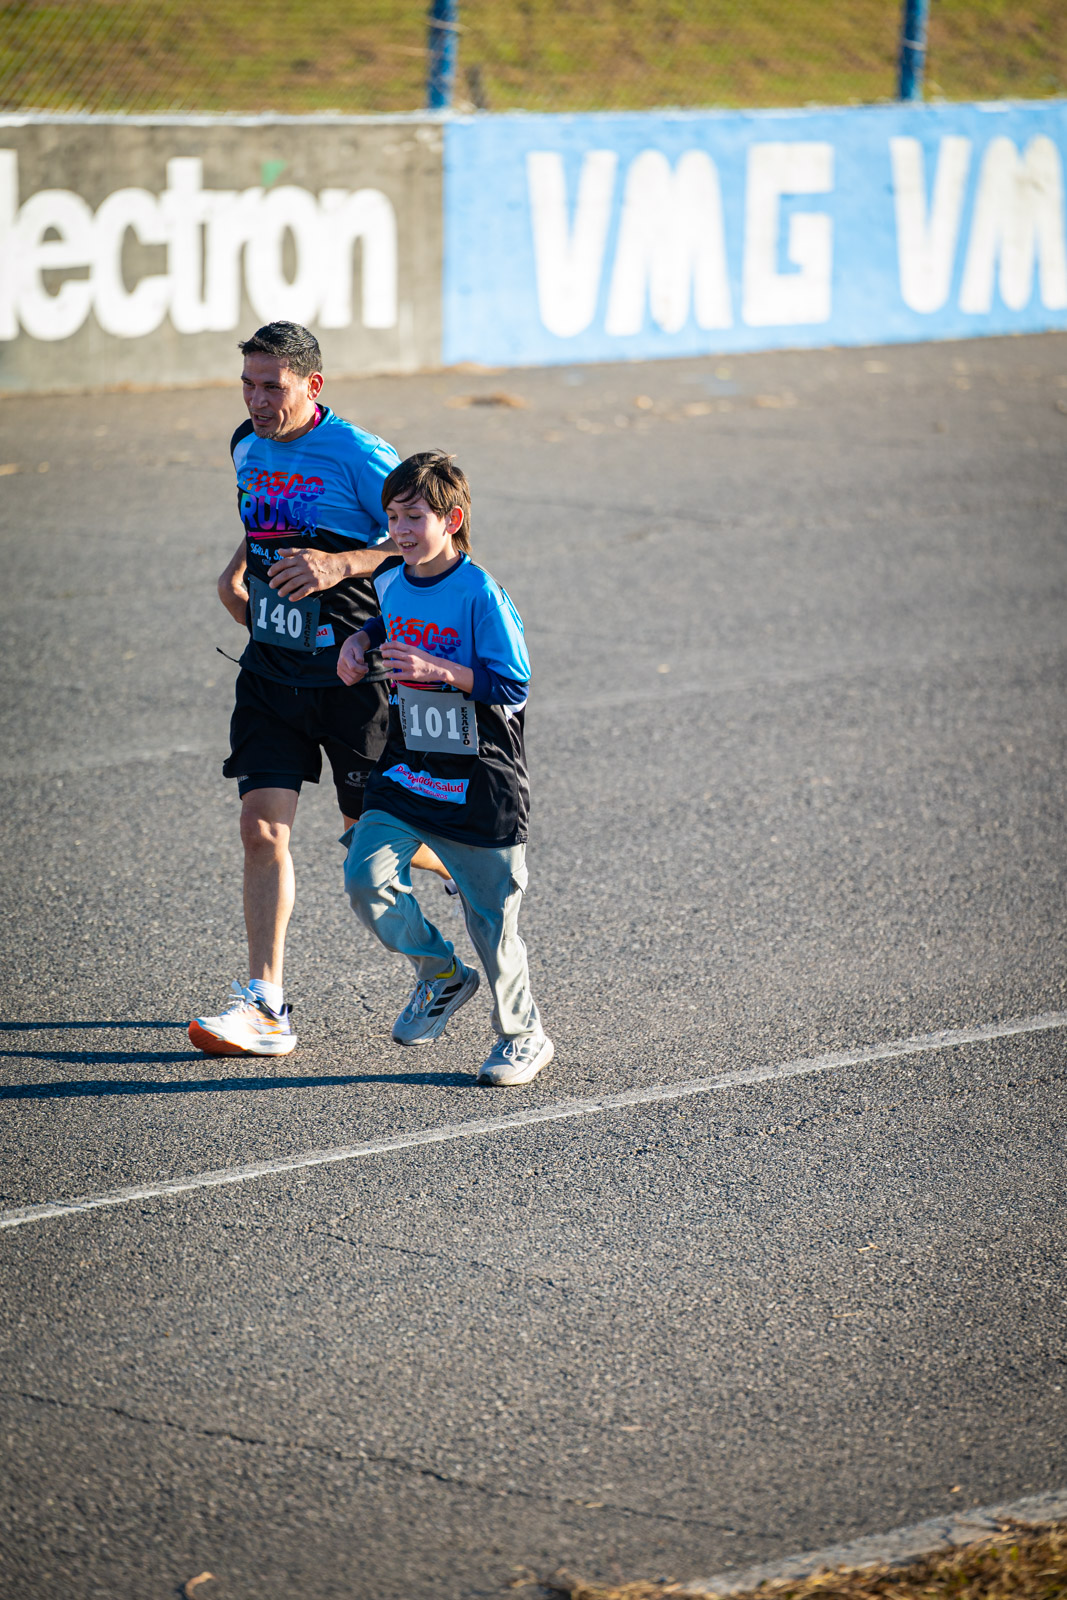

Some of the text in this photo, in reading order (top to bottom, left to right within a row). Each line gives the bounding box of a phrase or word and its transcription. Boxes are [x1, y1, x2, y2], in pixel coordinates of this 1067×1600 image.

[527, 141, 834, 337] VMG
[293, 484, 326, 495] MILLAS
[240, 492, 303, 531] RUN
[257, 597, 303, 639] 140
[431, 634, 462, 648] MILLAS
[409, 703, 461, 740] 101
[460, 706, 471, 746] EXACTO
[423, 788, 449, 800] SEGUROS
